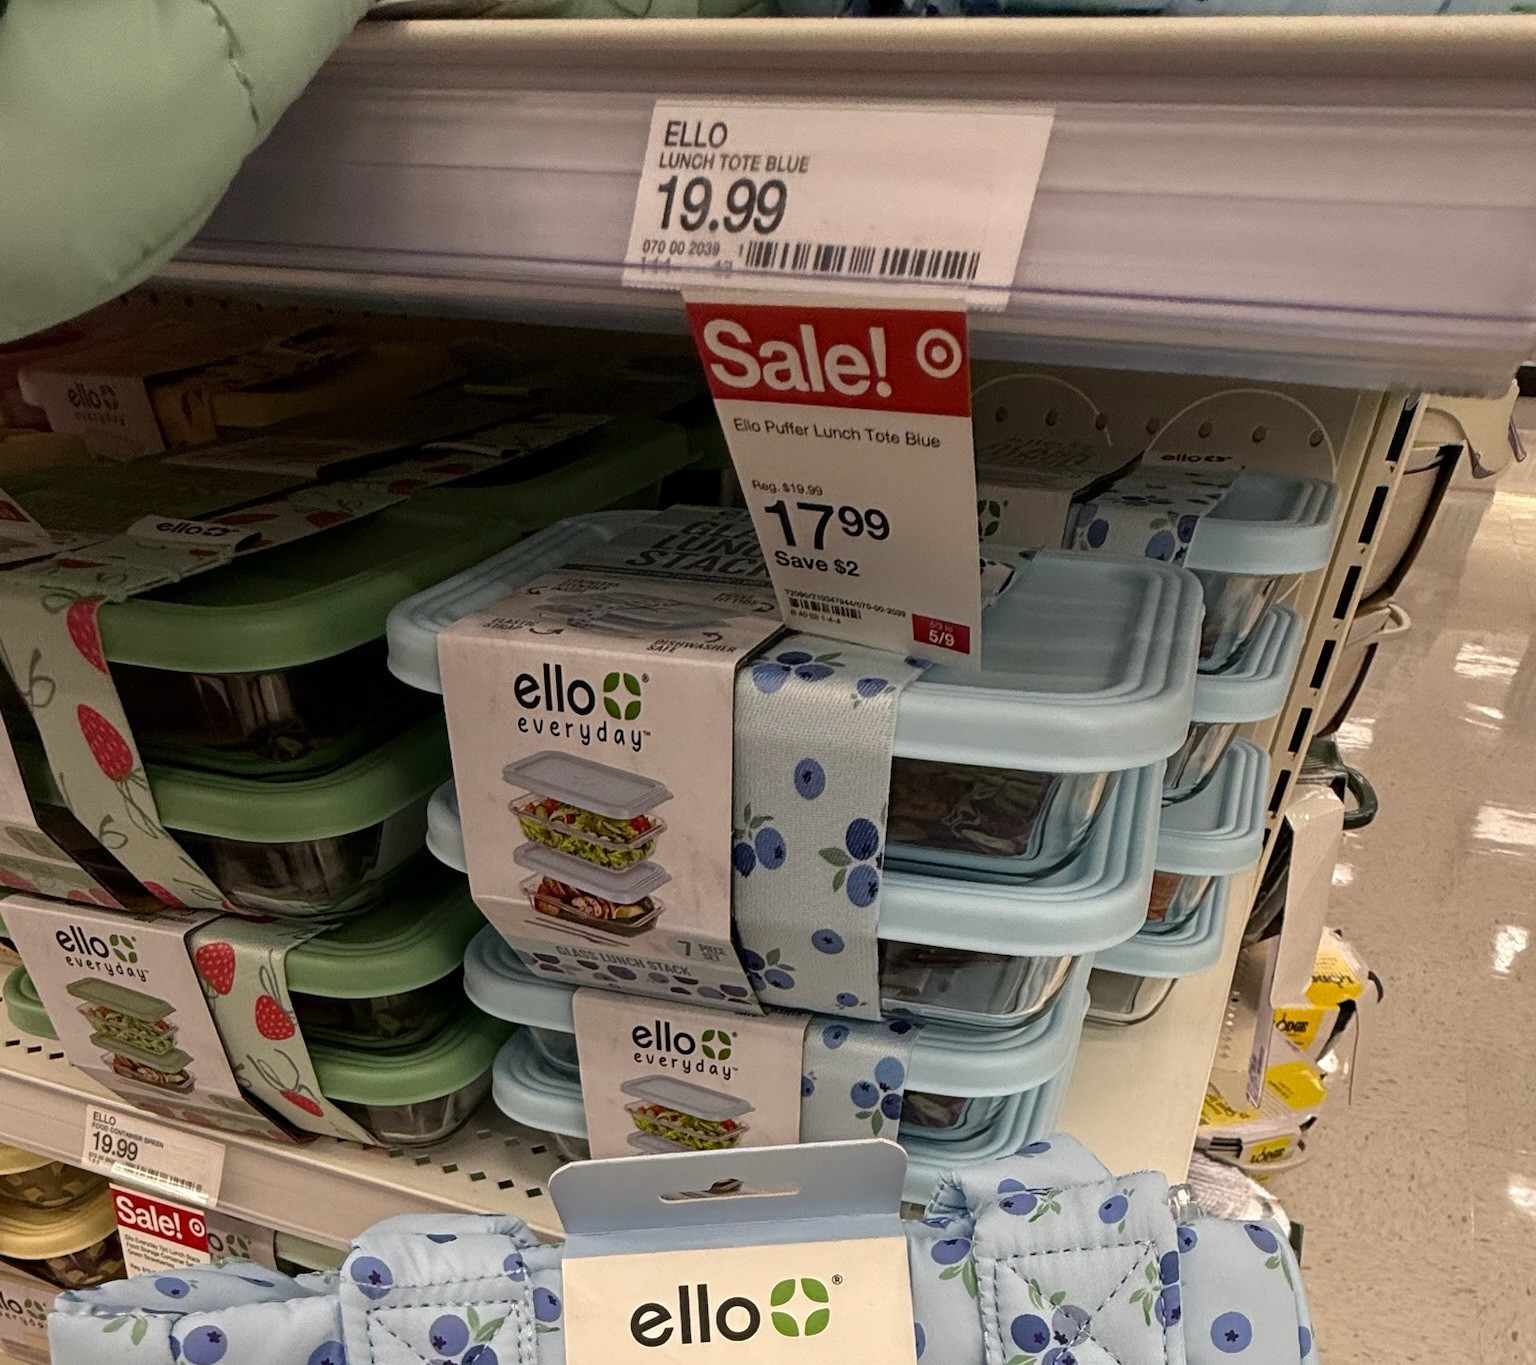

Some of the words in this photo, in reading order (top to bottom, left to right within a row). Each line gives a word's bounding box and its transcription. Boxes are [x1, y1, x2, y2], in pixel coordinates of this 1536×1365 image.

[663, 119, 728, 149] ELLO
[658, 152, 715, 172] LUNCH
[719, 153, 762, 173] TOTE
[766, 155, 811, 175] BLUE
[657, 175, 788, 235] 19.99
[642, 239, 666, 255] 070
[669, 240, 686, 256] 00
[688, 240, 721, 257] 2039
[704, 318, 893, 398] Sale!
[733, 418, 762, 434] Ello
[765, 420, 809, 438] Puffer
[814, 424, 861, 442] Lunch
[865, 428, 901, 446] Tote
[905, 431, 941, 449] Blue
[752, 479, 780, 495] Reg.
[783, 482, 824, 497] $19.99
[156, 522, 203, 535] ello
[774, 550, 829, 574] Save
[834, 559, 861, 578] $2
[929, 629, 955, 647] 5/9
[513, 663, 596, 716] ello
[56, 925, 110, 959] ello
[677, 939, 691, 957] 7
[555, 945, 599, 961] GLASS
[600, 953, 646, 969] LUNCH
[646, 960, 692, 977] STACK
[631, 1019, 696, 1056] ello
[91, 1121, 109, 1133] FOOD
[93, 1111, 117, 1126] ELLO
[92, 1131, 139, 1161] 19.99
[115, 1195, 183, 1240] Sale!
[630, 1283, 761, 1348] ello
